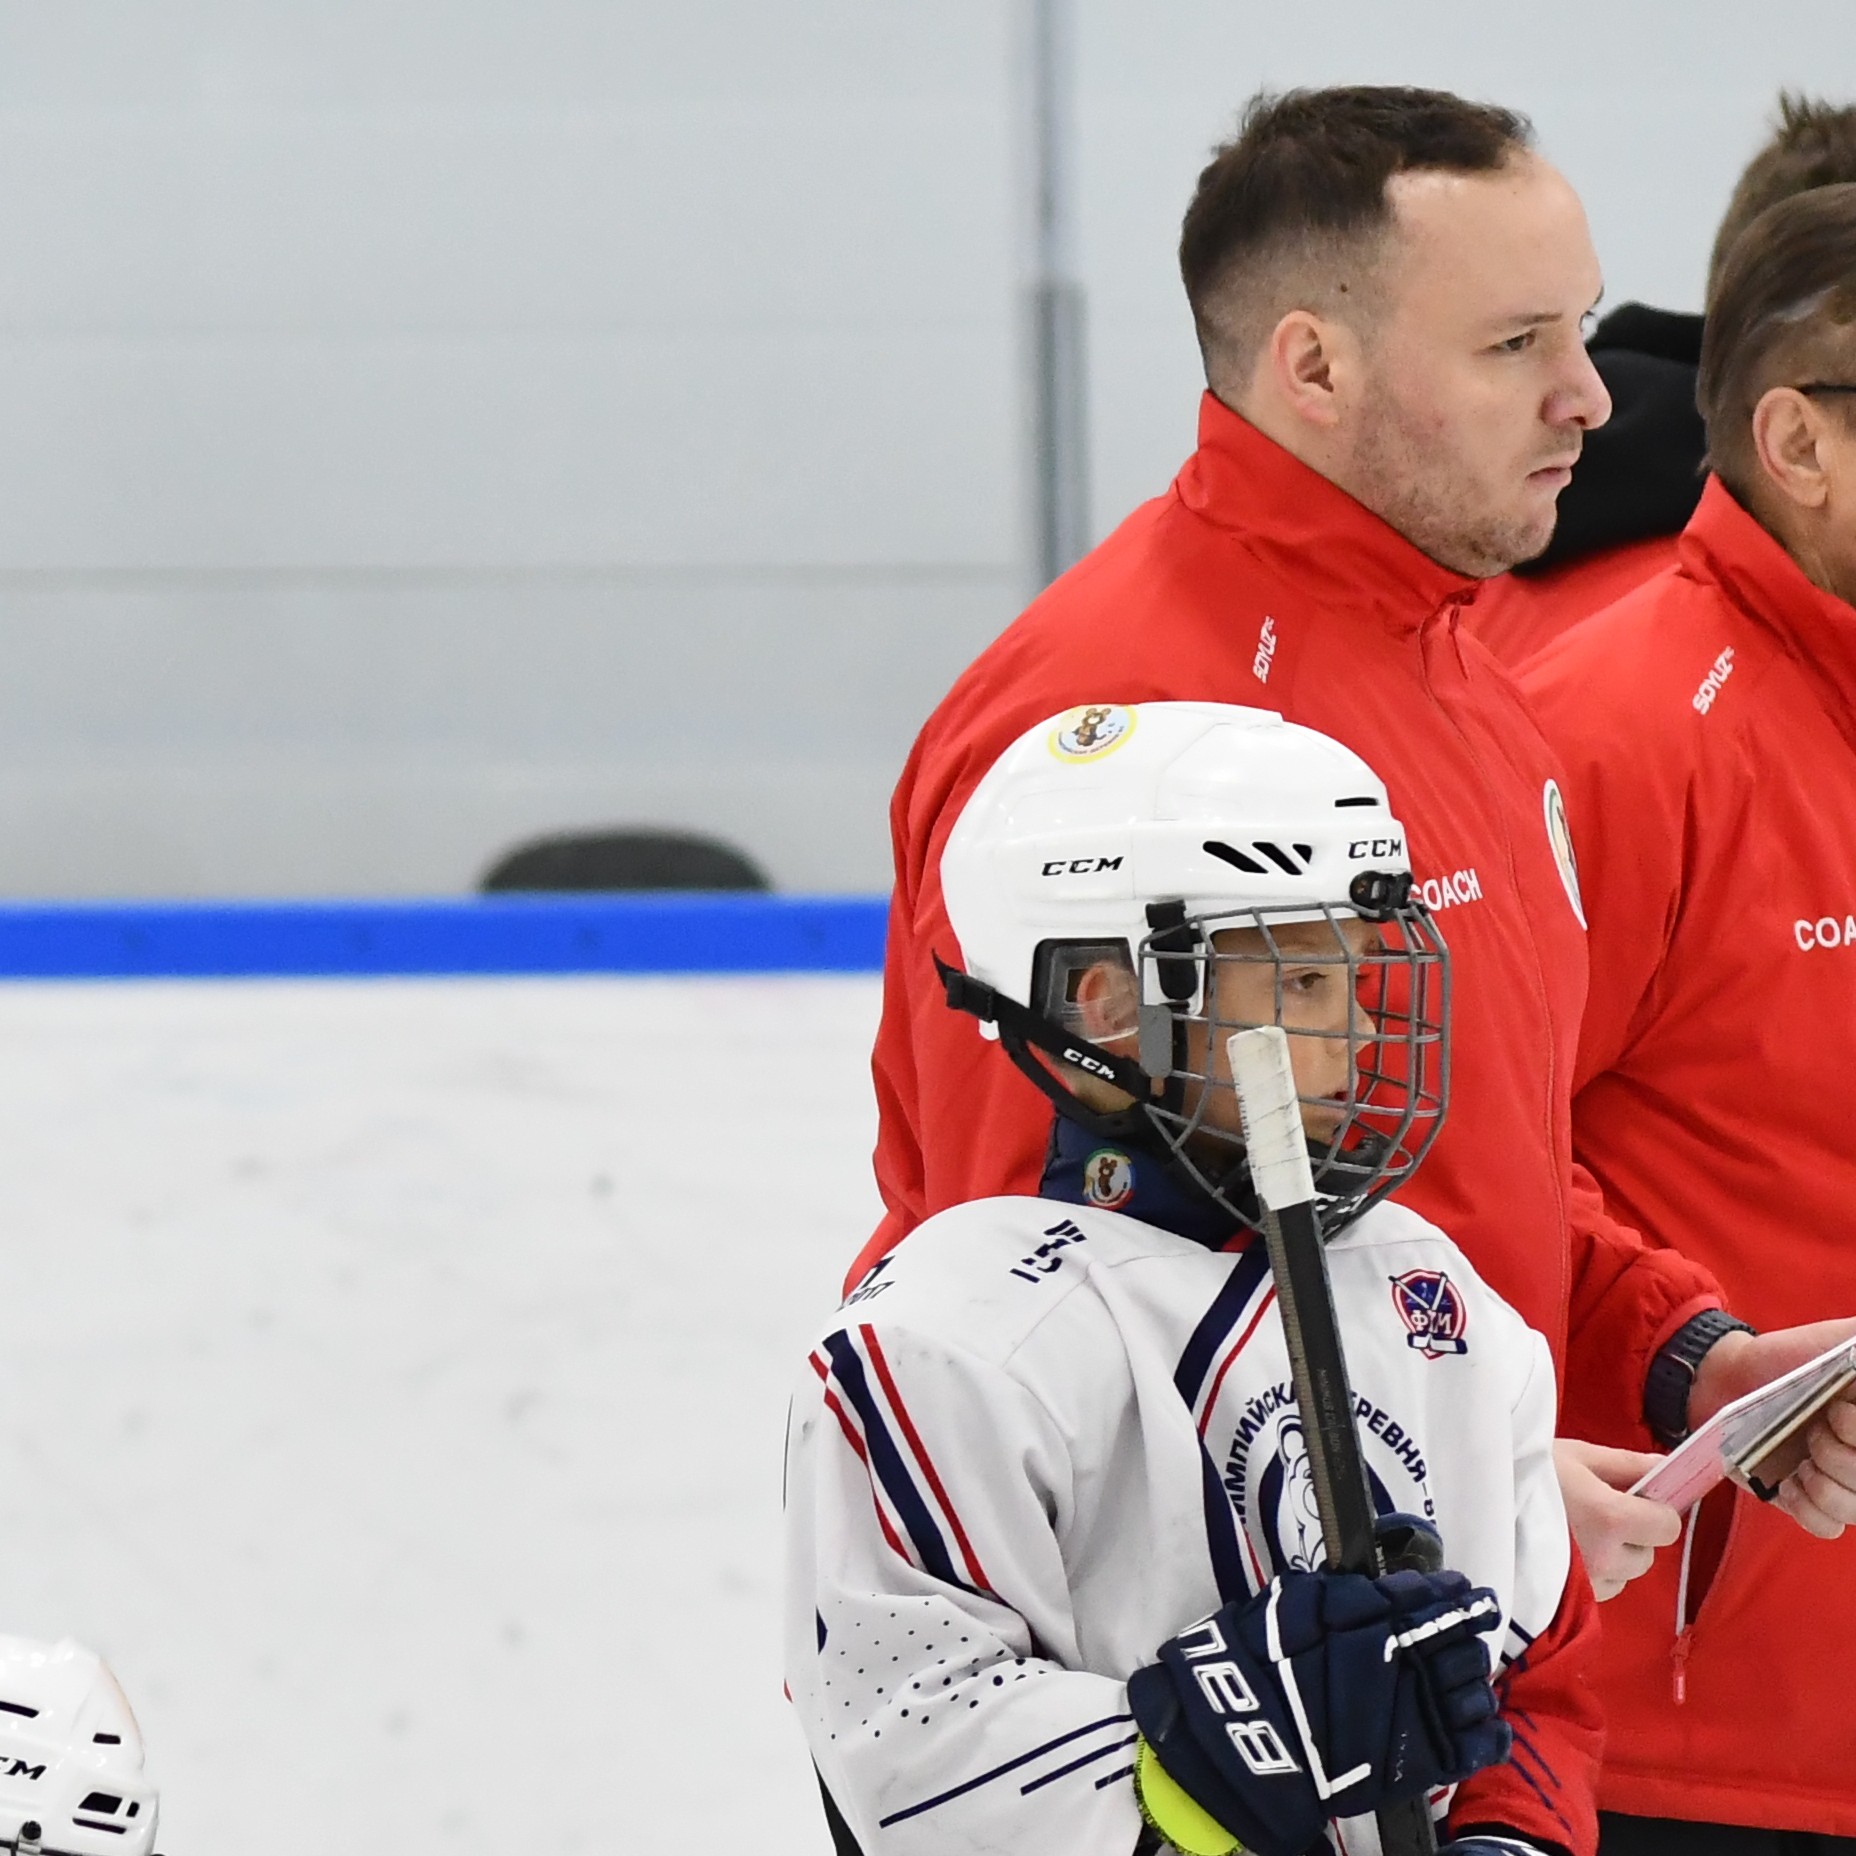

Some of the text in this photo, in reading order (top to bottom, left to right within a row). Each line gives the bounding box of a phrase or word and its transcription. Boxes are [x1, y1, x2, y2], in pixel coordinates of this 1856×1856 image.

[1348, 838, 1402, 860] CCM
[1041, 855, 1125, 877] CCM
[1062, 1046, 1115, 1079] CCM
